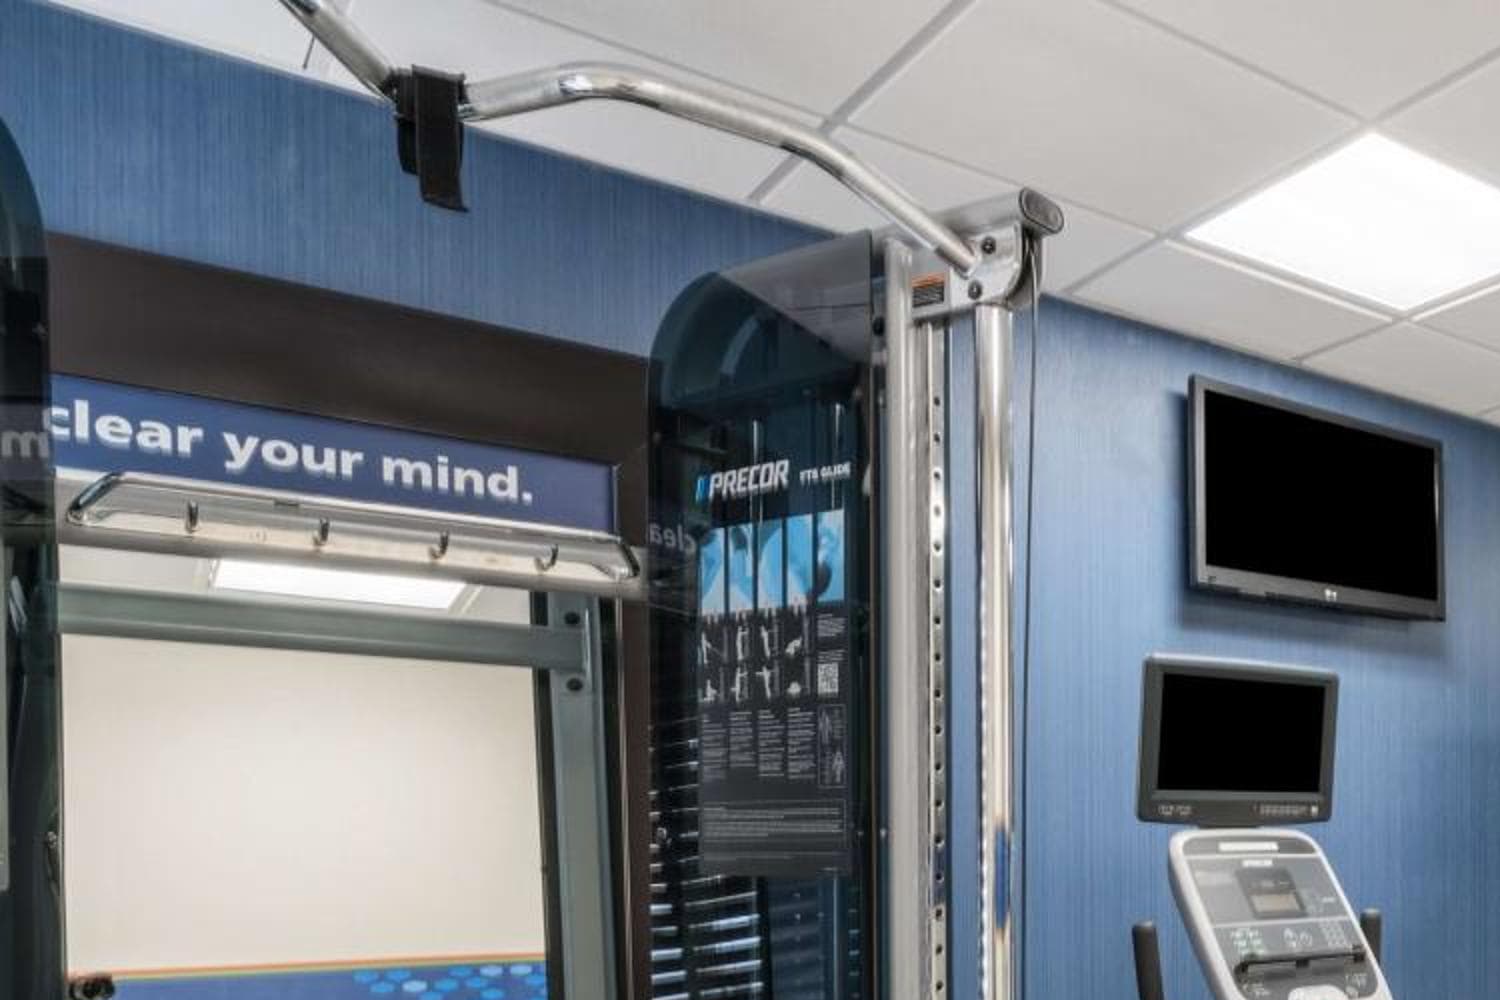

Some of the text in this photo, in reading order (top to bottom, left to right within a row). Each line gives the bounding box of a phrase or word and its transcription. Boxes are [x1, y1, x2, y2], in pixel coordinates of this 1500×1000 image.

[43, 400, 533, 504] clear your mind.
[709, 460, 789, 500] PRECOR
